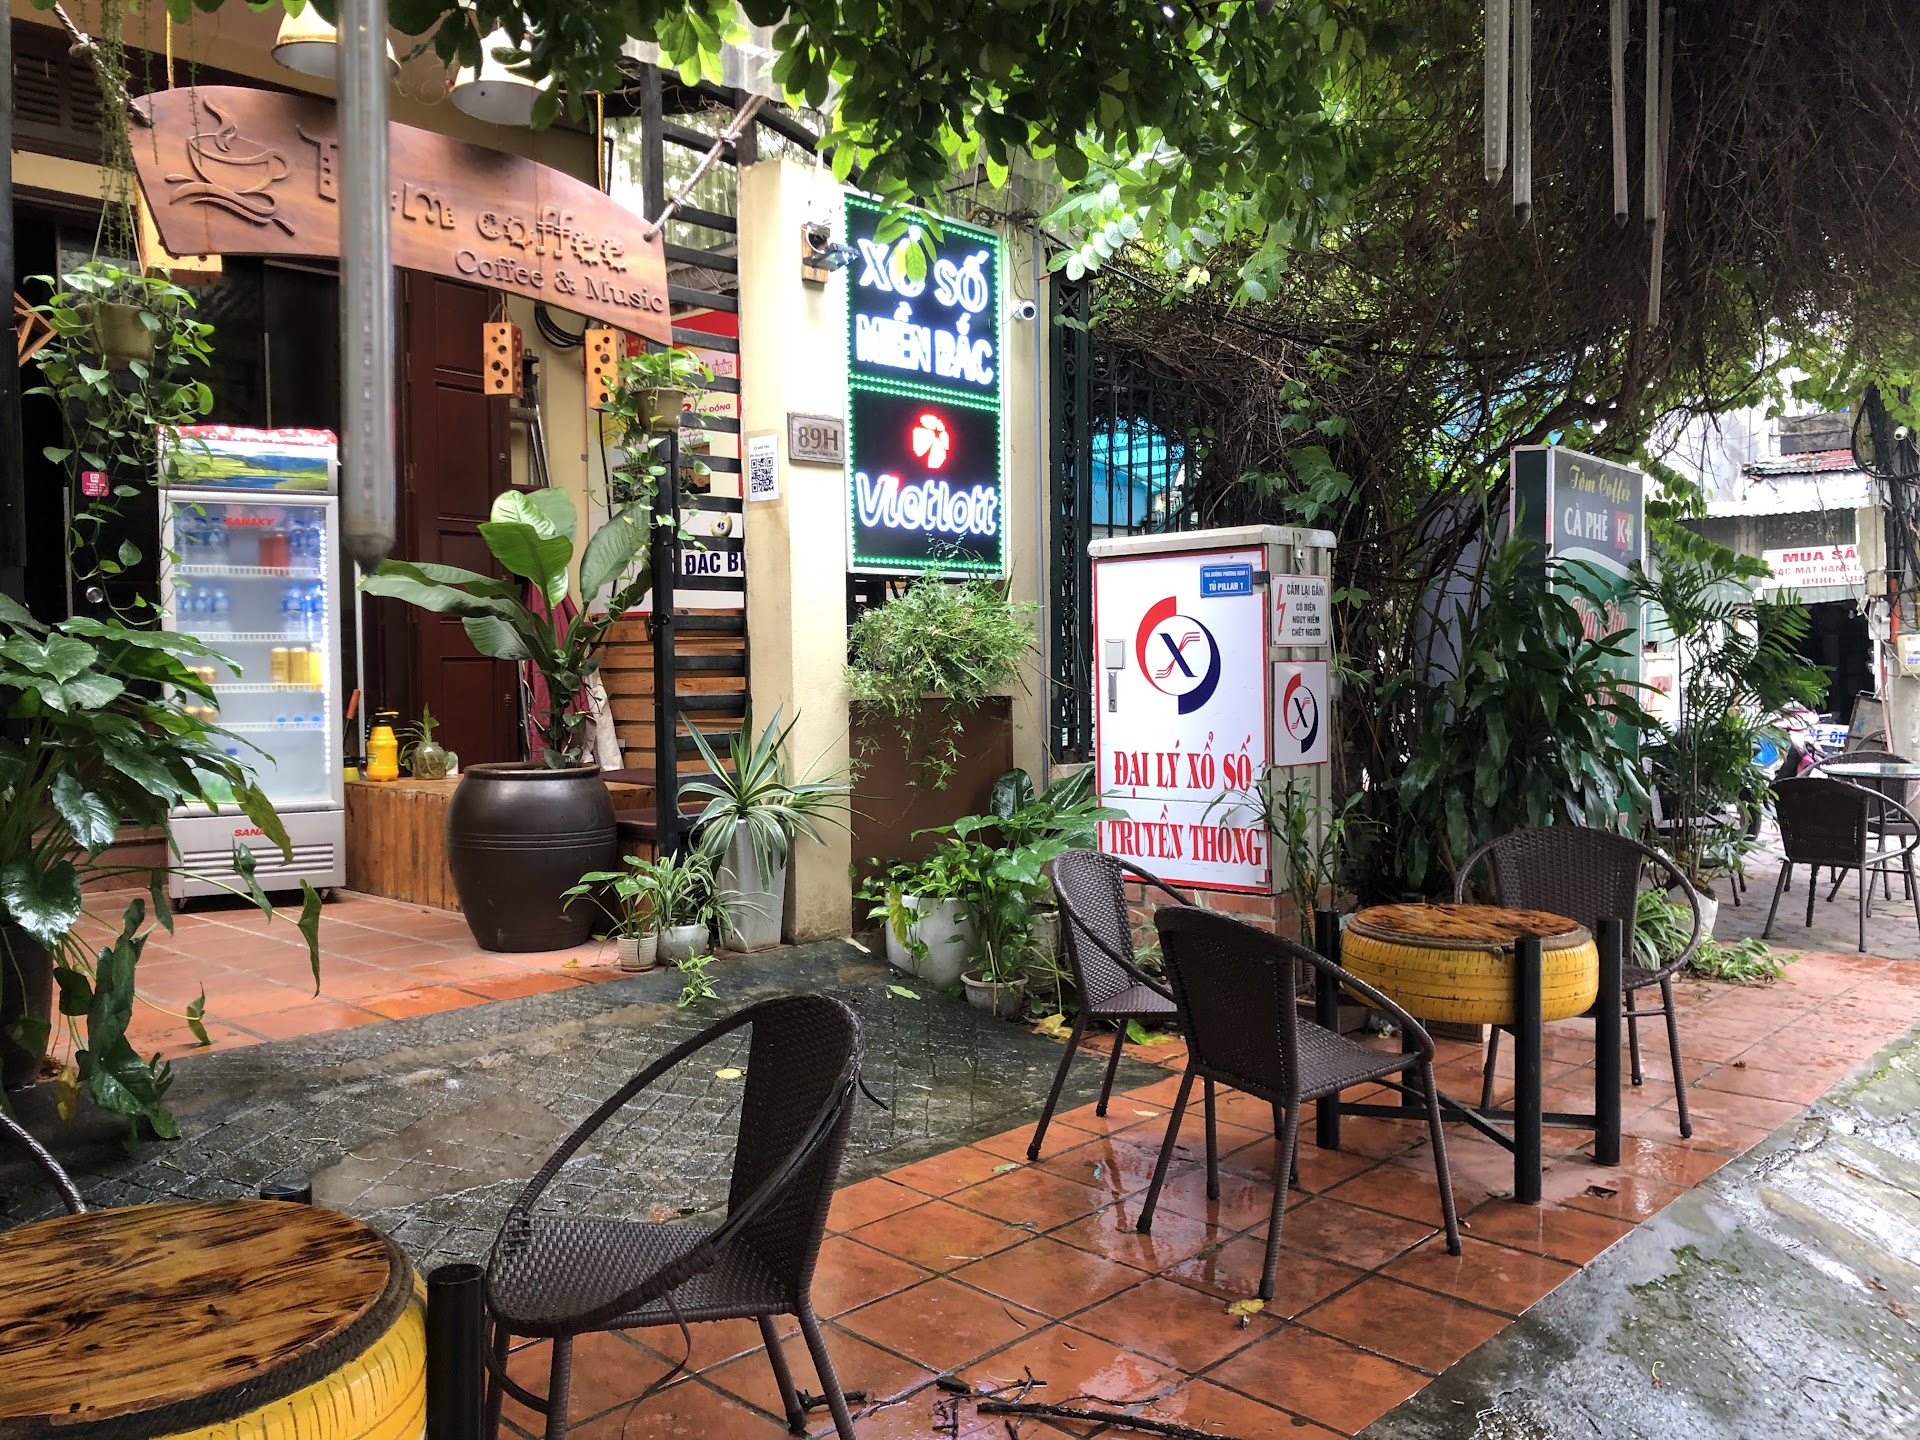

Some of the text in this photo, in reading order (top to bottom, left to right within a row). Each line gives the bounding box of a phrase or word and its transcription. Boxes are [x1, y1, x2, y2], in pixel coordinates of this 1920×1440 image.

[296, 124, 455, 230] Tm
[455, 249, 665, 313] Coffee & Music
[934, 250, 989, 313] SỐ
[856, 301, 994, 385] MIỀN BẮC
[797, 426, 839, 451] 89H
[855, 472, 998, 536] Vietlott
[1564, 502, 1582, 537] CÀ
[1585, 508, 1608, 542] PHÊ
[1782, 551, 1824, 563] MUA
[1209, 580, 1244, 592] TỦ PILLAR 1
[1301, 584, 1311, 599] LẠI
[1292, 615, 1306, 624] NGUY
[1295, 601, 1303, 612] CÓ
[1291, 626, 1304, 637] CHẾT
[1114, 731, 1252, 798] ĐẠI LÝ XỔ SỐ
[234, 828, 267, 837] SANA
[1108, 803, 1263, 866] TRUYỀN THỐNG
